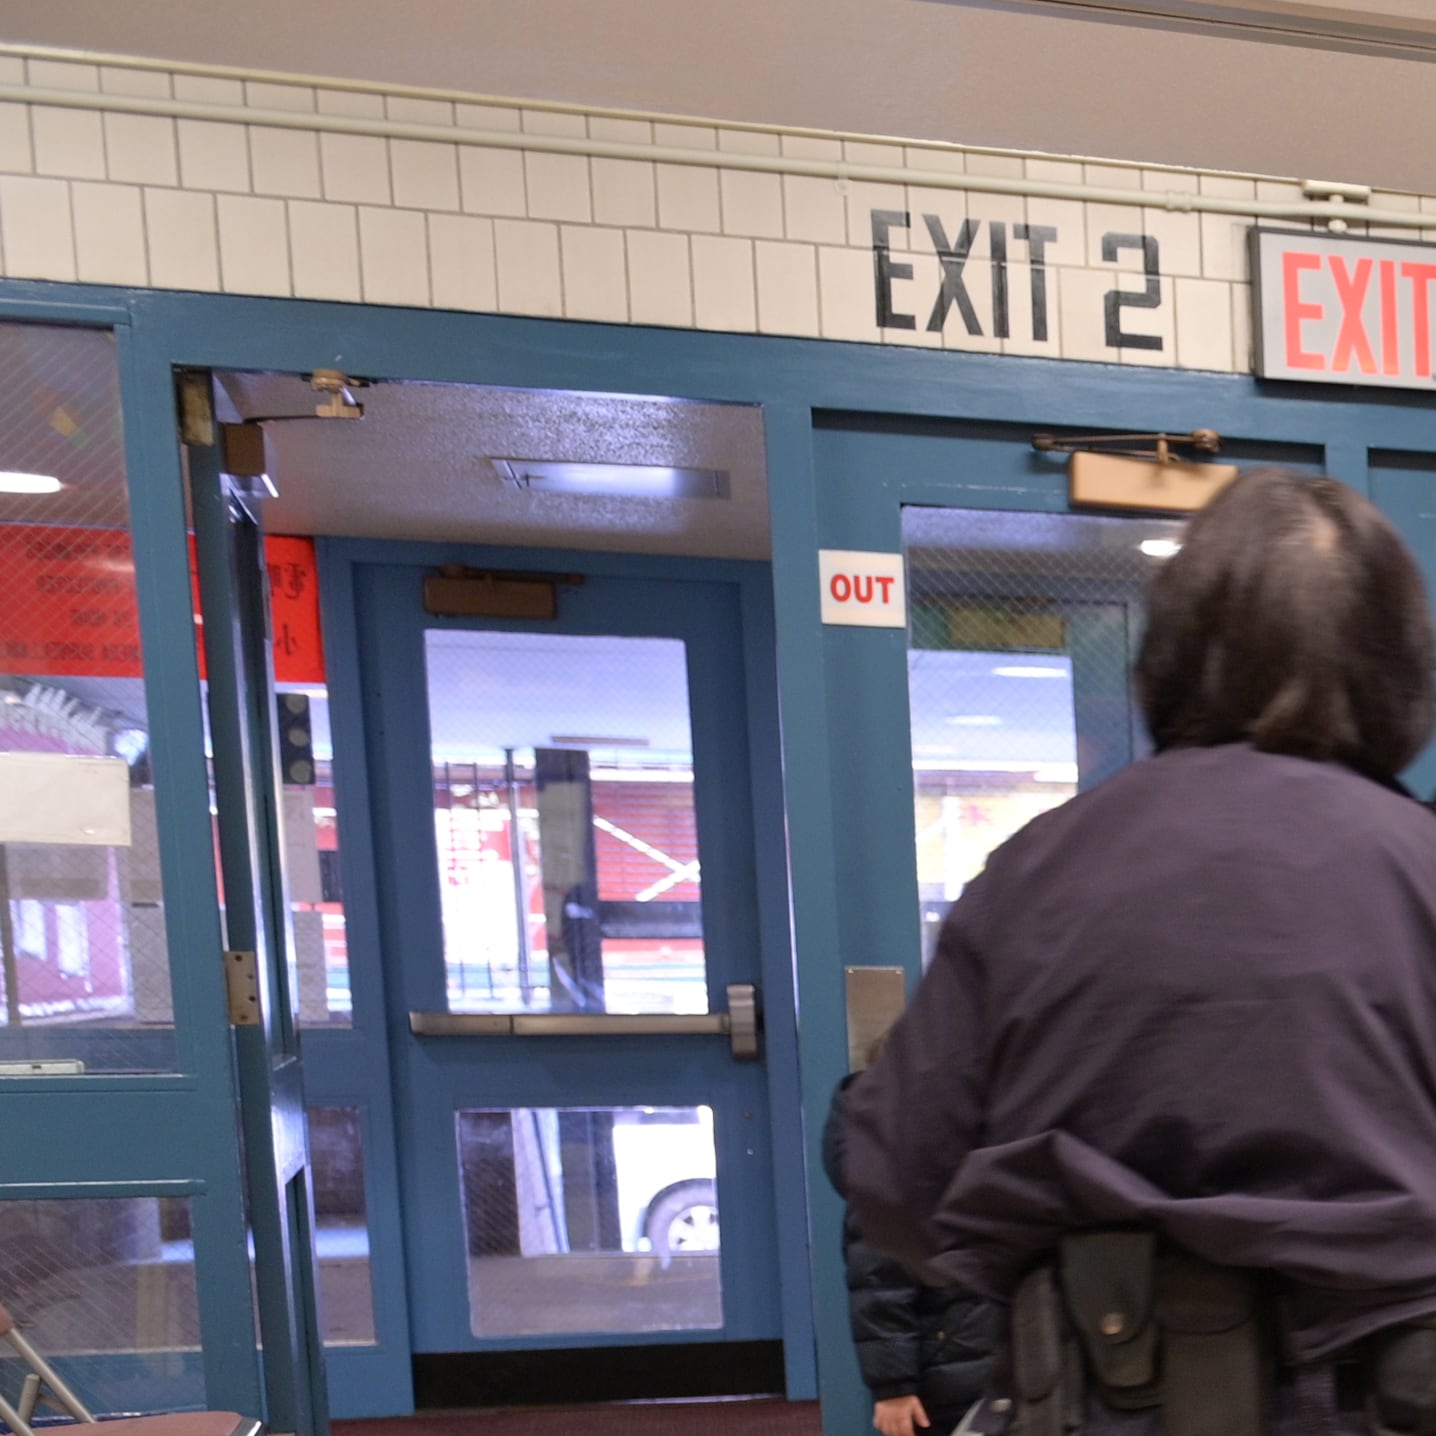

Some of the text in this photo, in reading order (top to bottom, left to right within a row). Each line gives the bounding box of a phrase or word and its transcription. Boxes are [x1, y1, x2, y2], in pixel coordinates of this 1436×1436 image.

[870, 208, 1164, 351] EXIT 2
[830, 573, 895, 605] OUT
